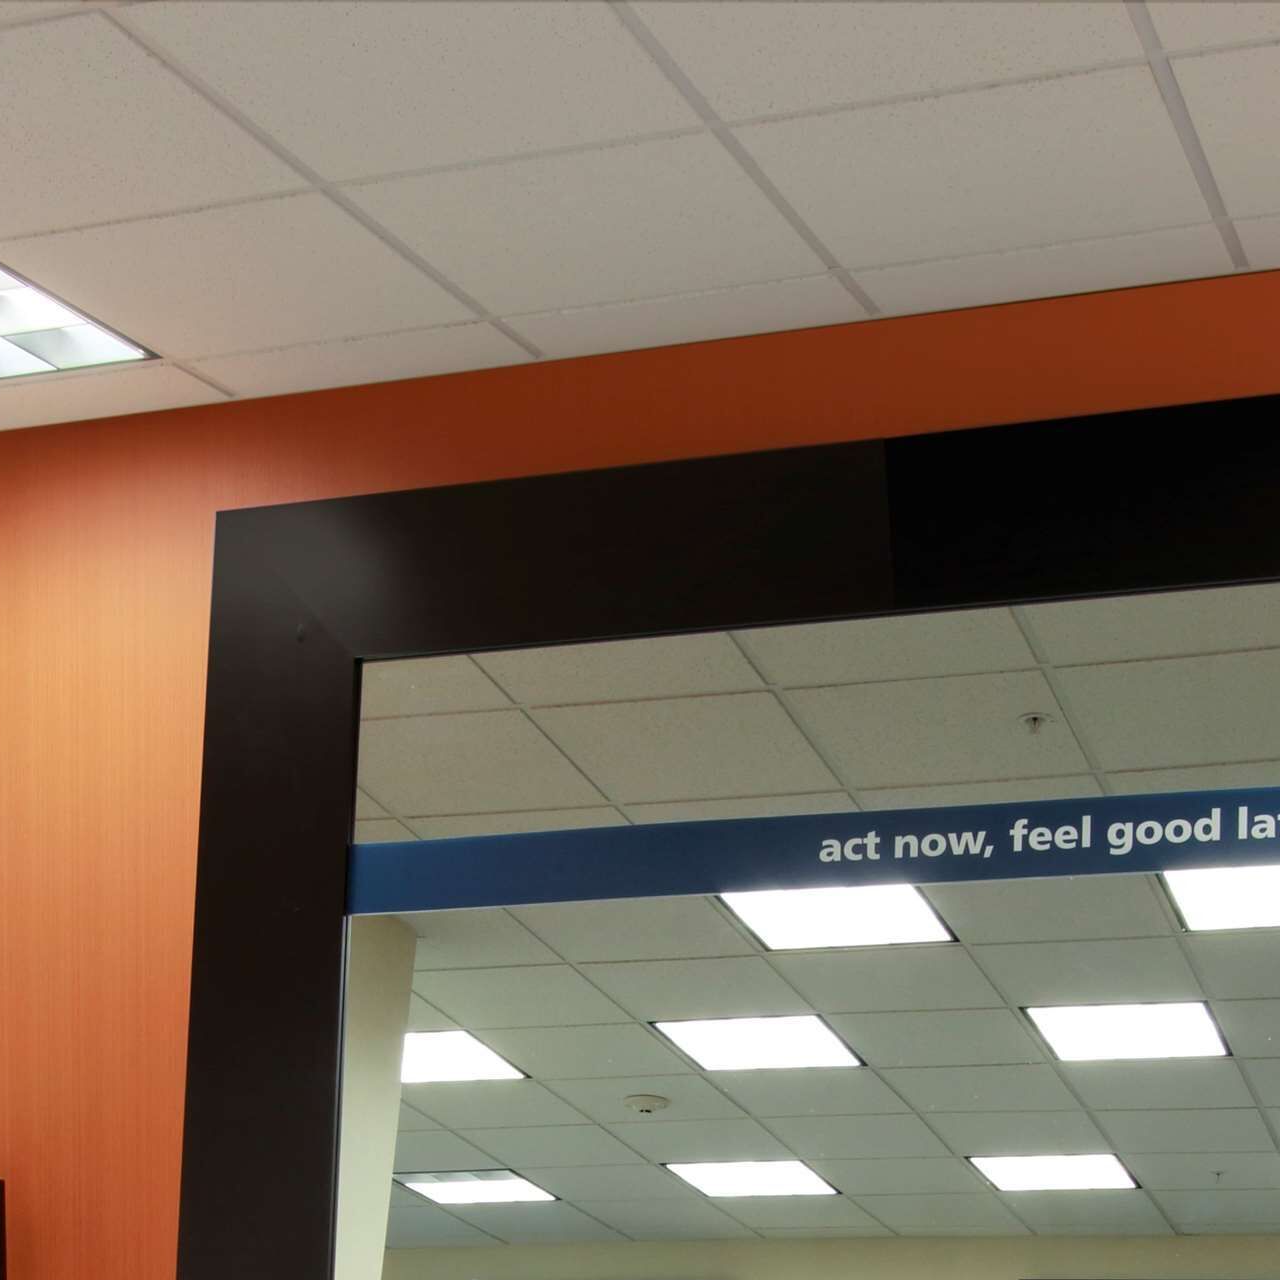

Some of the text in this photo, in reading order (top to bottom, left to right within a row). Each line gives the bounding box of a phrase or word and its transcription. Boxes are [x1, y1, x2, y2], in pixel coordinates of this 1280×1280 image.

[819, 830, 881, 862] act
[894, 830, 994, 859] now,
[1010, 815, 1092, 852] feel
[1107, 807, 1221, 856] good
